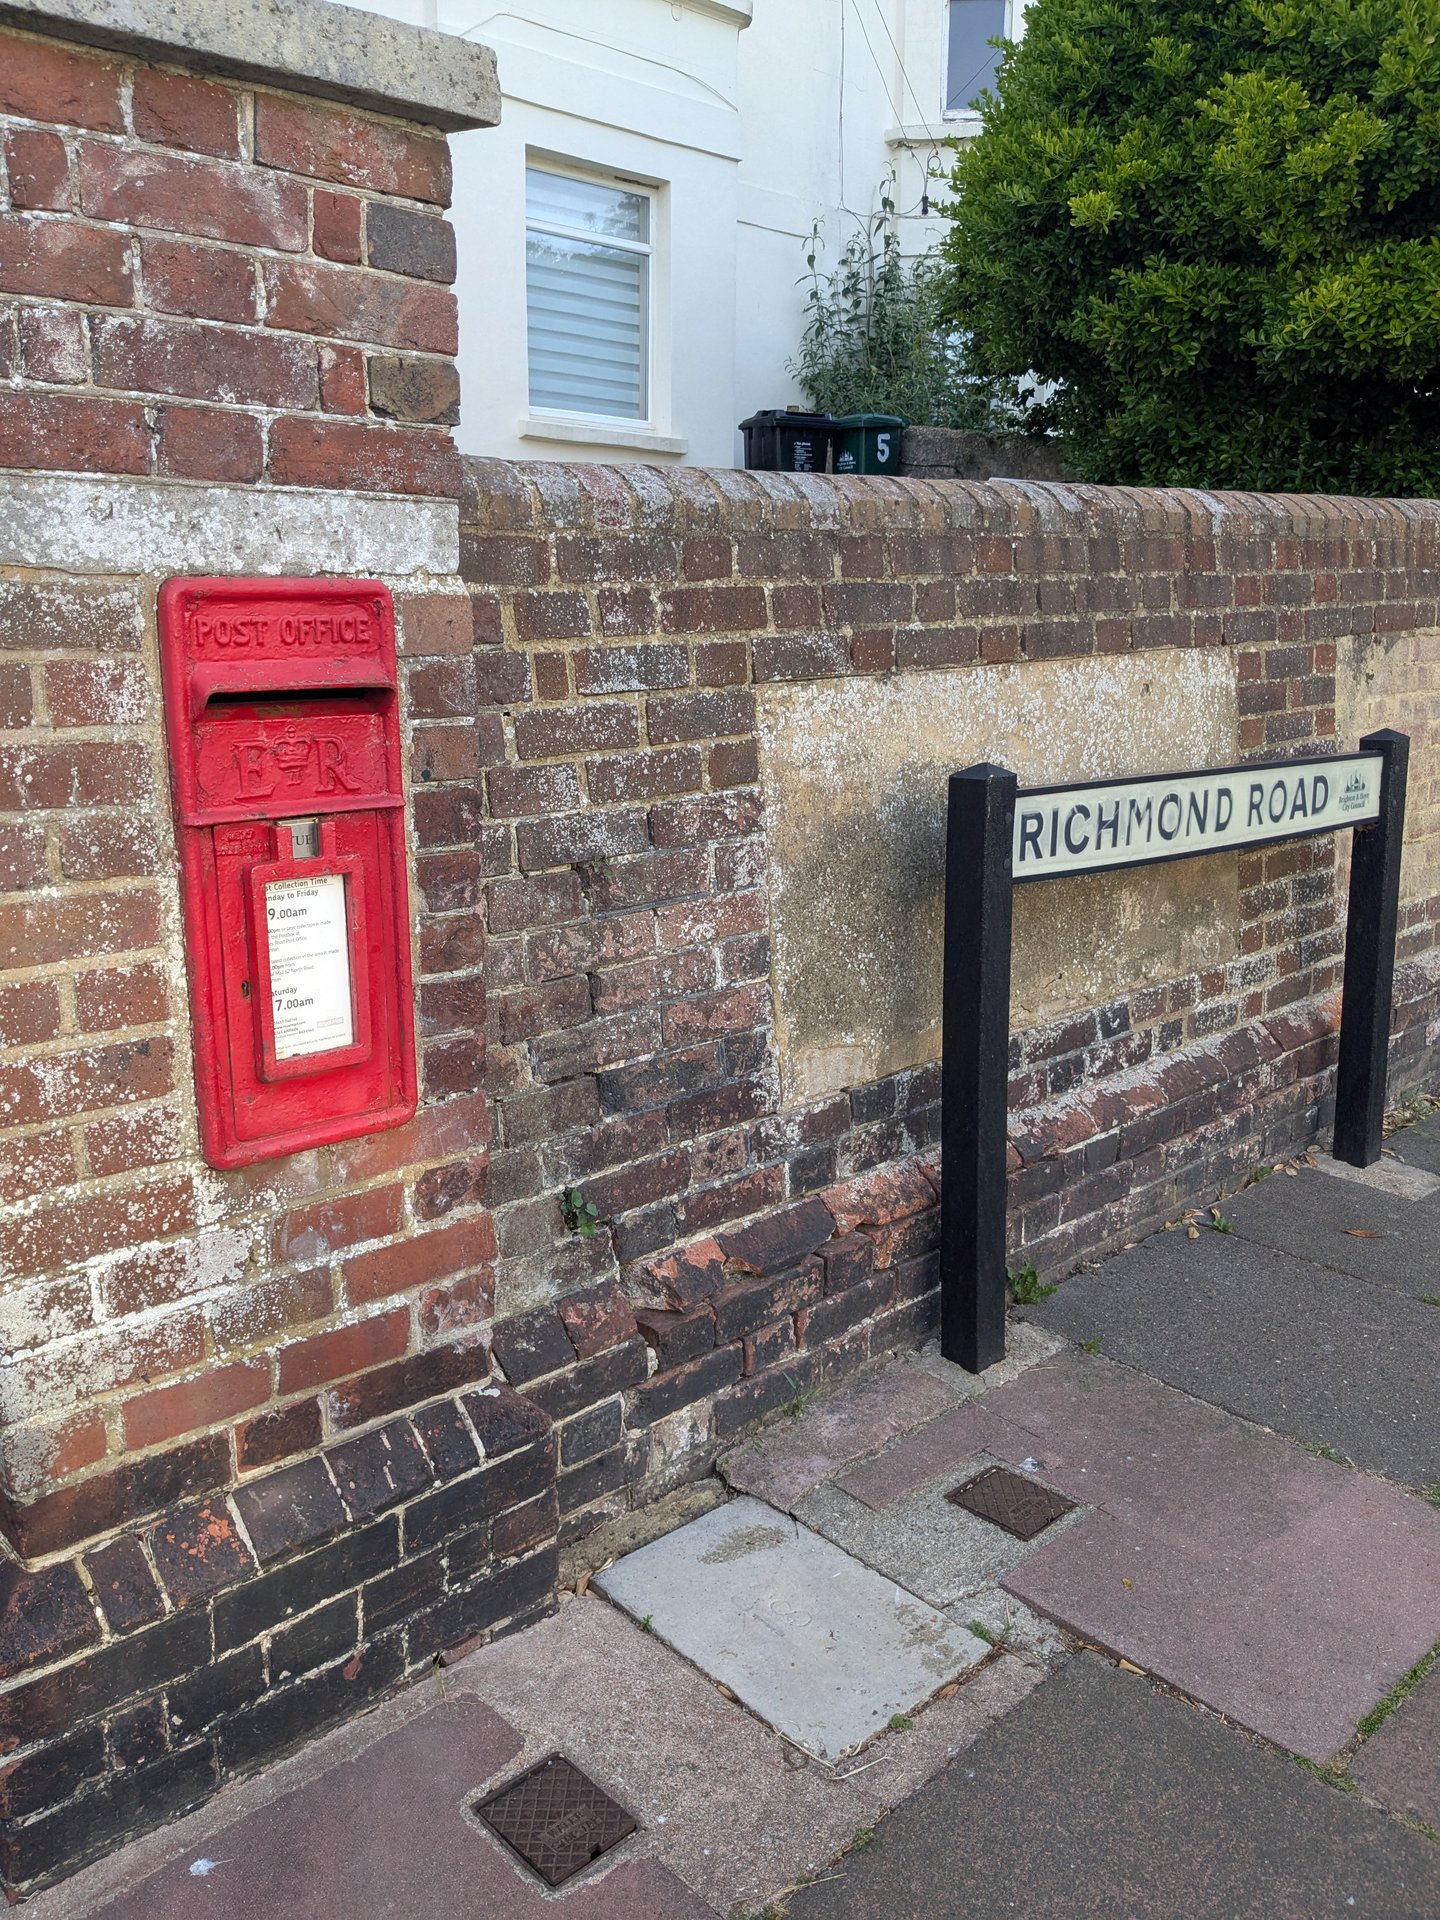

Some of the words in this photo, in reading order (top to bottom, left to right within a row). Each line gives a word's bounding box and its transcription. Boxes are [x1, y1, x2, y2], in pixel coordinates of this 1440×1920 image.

[877, 433, 891, 463] 5
[195, 614, 269, 647] POST
[279, 615, 371, 645] OFFICE
[1019, 786, 1234, 862] RICHMOND
[1247, 775, 1329, 827] ROAD
[293, 834, 312, 846] UE
[274, 879, 308, 890] Collection
[310, 877, 328, 886] Time
[287, 892, 295, 900] to
[297, 889, 319, 899] Friday
[267, 907, 308, 921] 9.00am
[275, 997, 314, 1012] 7.00am
